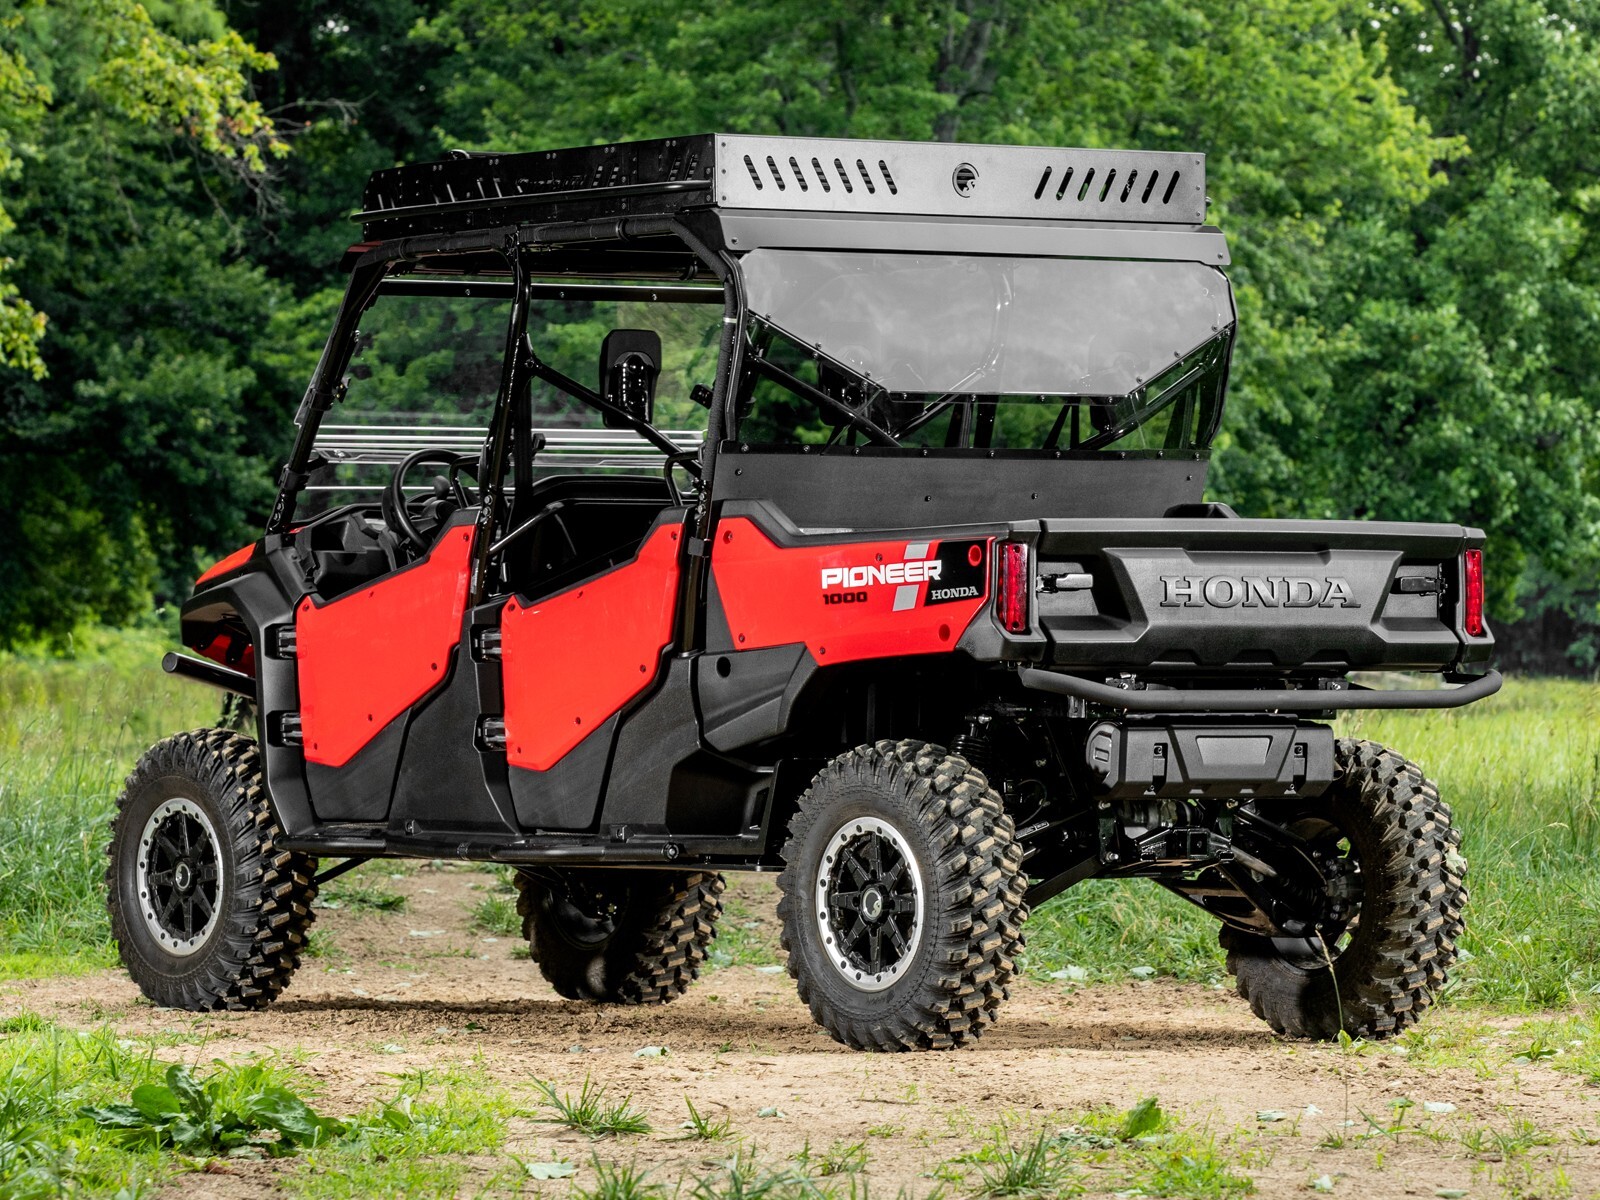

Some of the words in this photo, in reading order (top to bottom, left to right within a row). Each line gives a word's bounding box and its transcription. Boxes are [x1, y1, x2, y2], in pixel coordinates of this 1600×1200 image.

[821, 559, 942, 589] PIONEER
[822, 591, 868, 605] 1000
[931, 586, 979, 600] HONDA
[1159, 574, 1361, 608] HONDA
